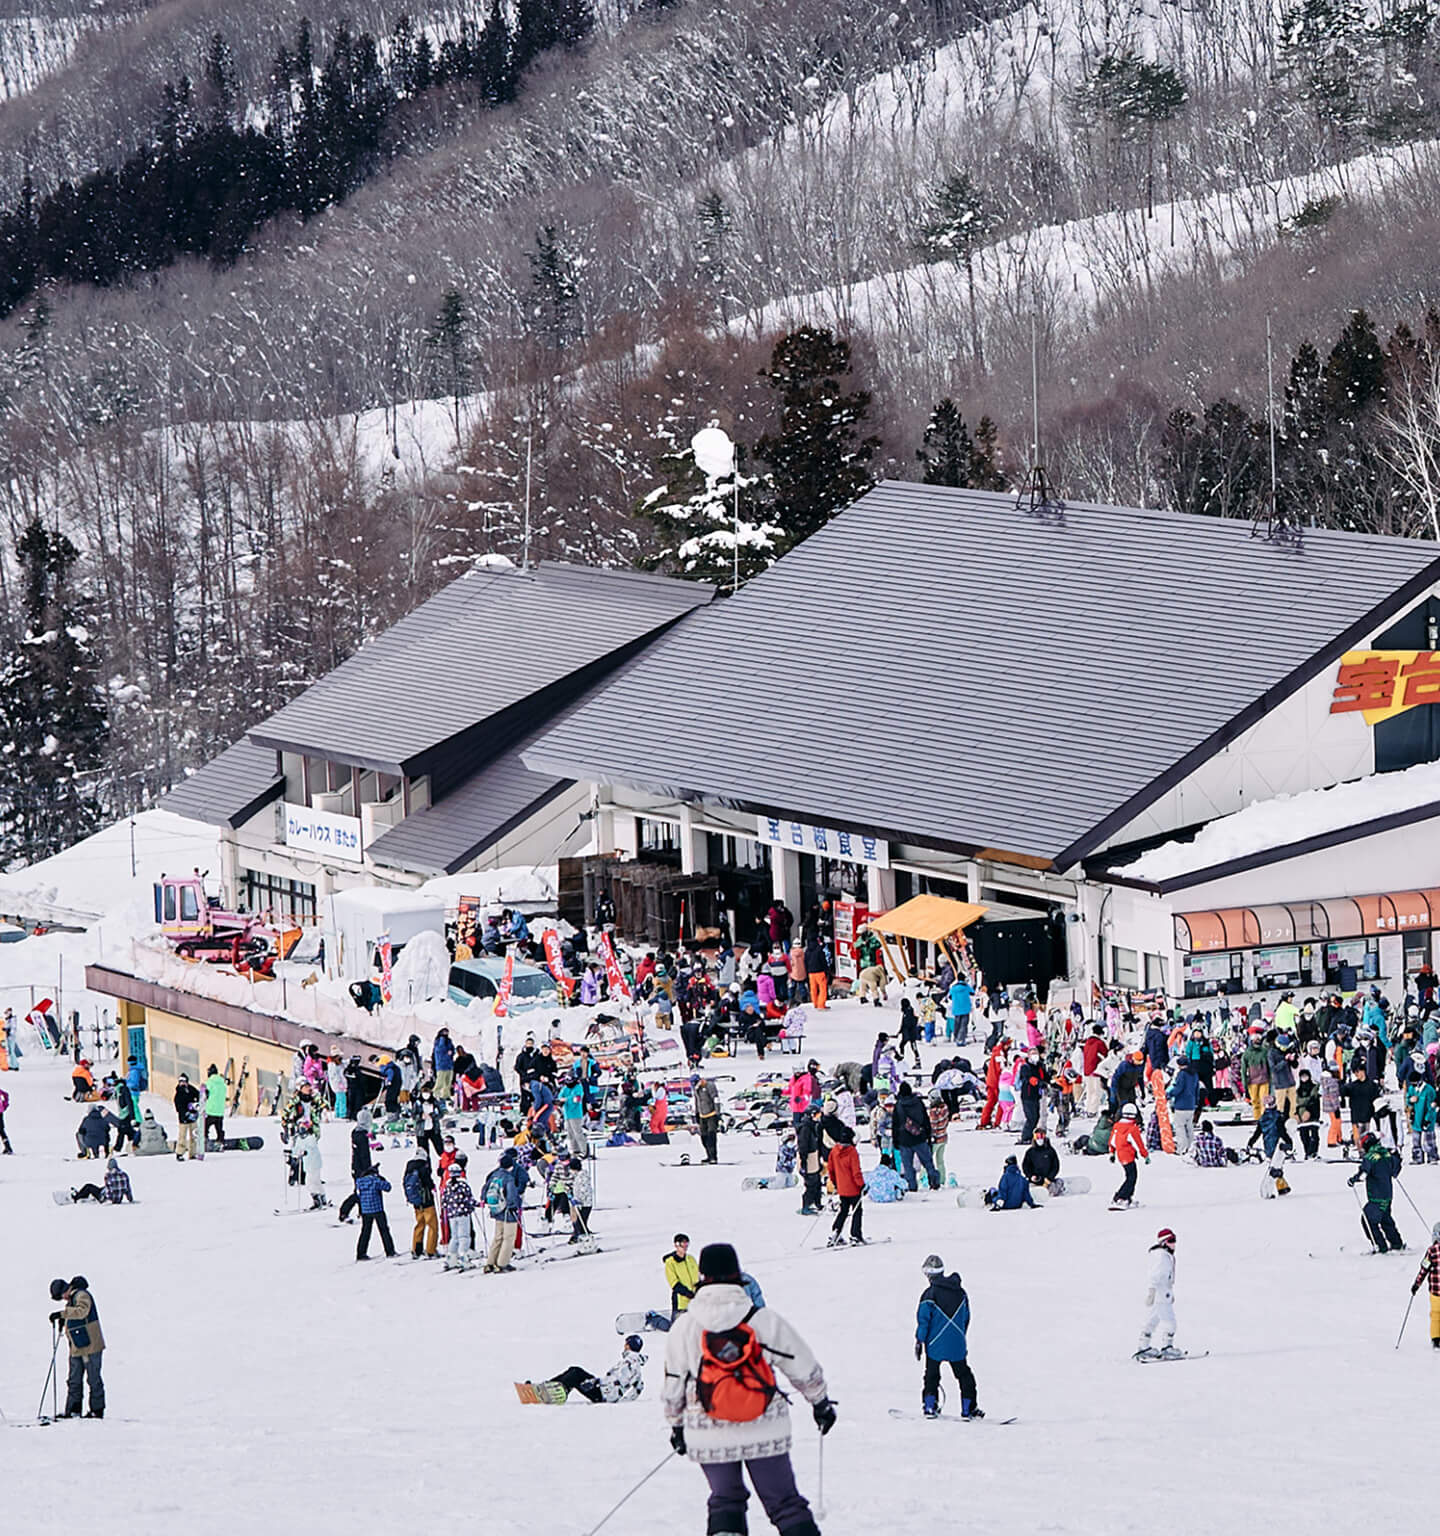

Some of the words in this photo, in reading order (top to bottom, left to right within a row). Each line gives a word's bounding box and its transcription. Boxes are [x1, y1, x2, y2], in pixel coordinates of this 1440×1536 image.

[288, 817, 331, 843] カレーハウス
[334, 828, 358, 849] ほたか
[1263, 927, 1292, 939] リフト
